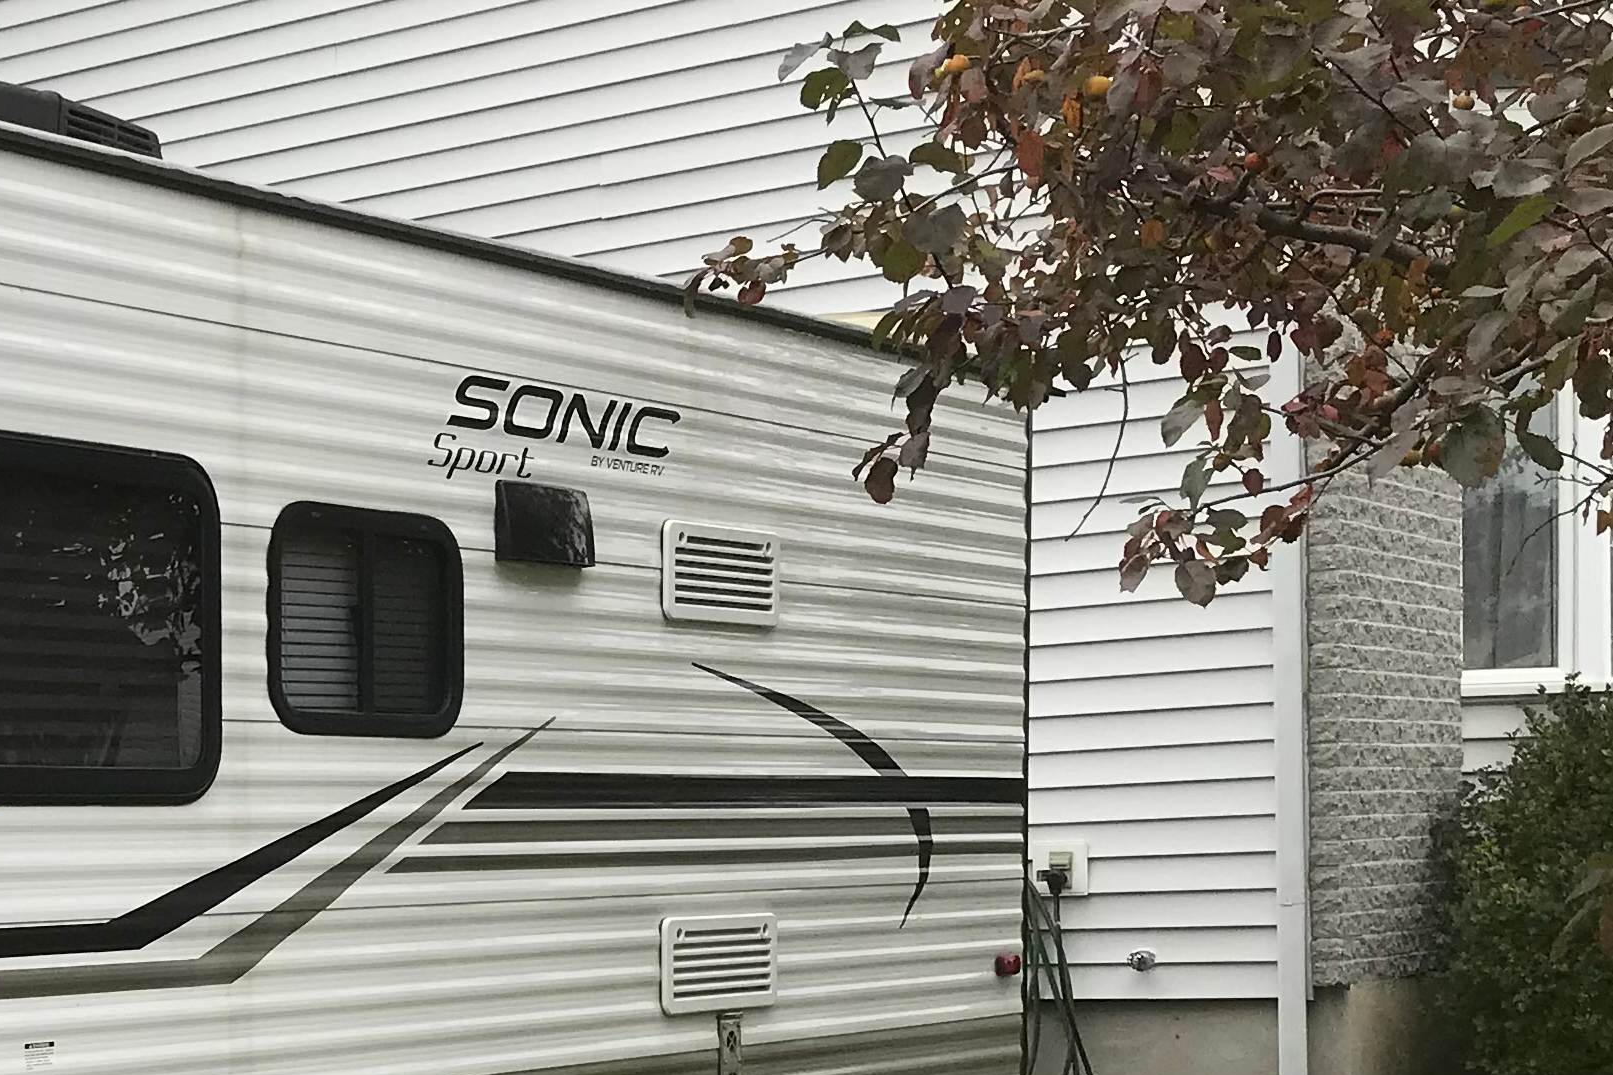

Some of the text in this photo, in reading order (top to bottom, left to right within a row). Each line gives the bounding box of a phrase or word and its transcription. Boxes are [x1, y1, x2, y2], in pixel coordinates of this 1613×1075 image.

[446, 374, 681, 459] SONIC
[427, 431, 535, 480] Sport
[590, 455, 665, 476] BY VENTURE RV
